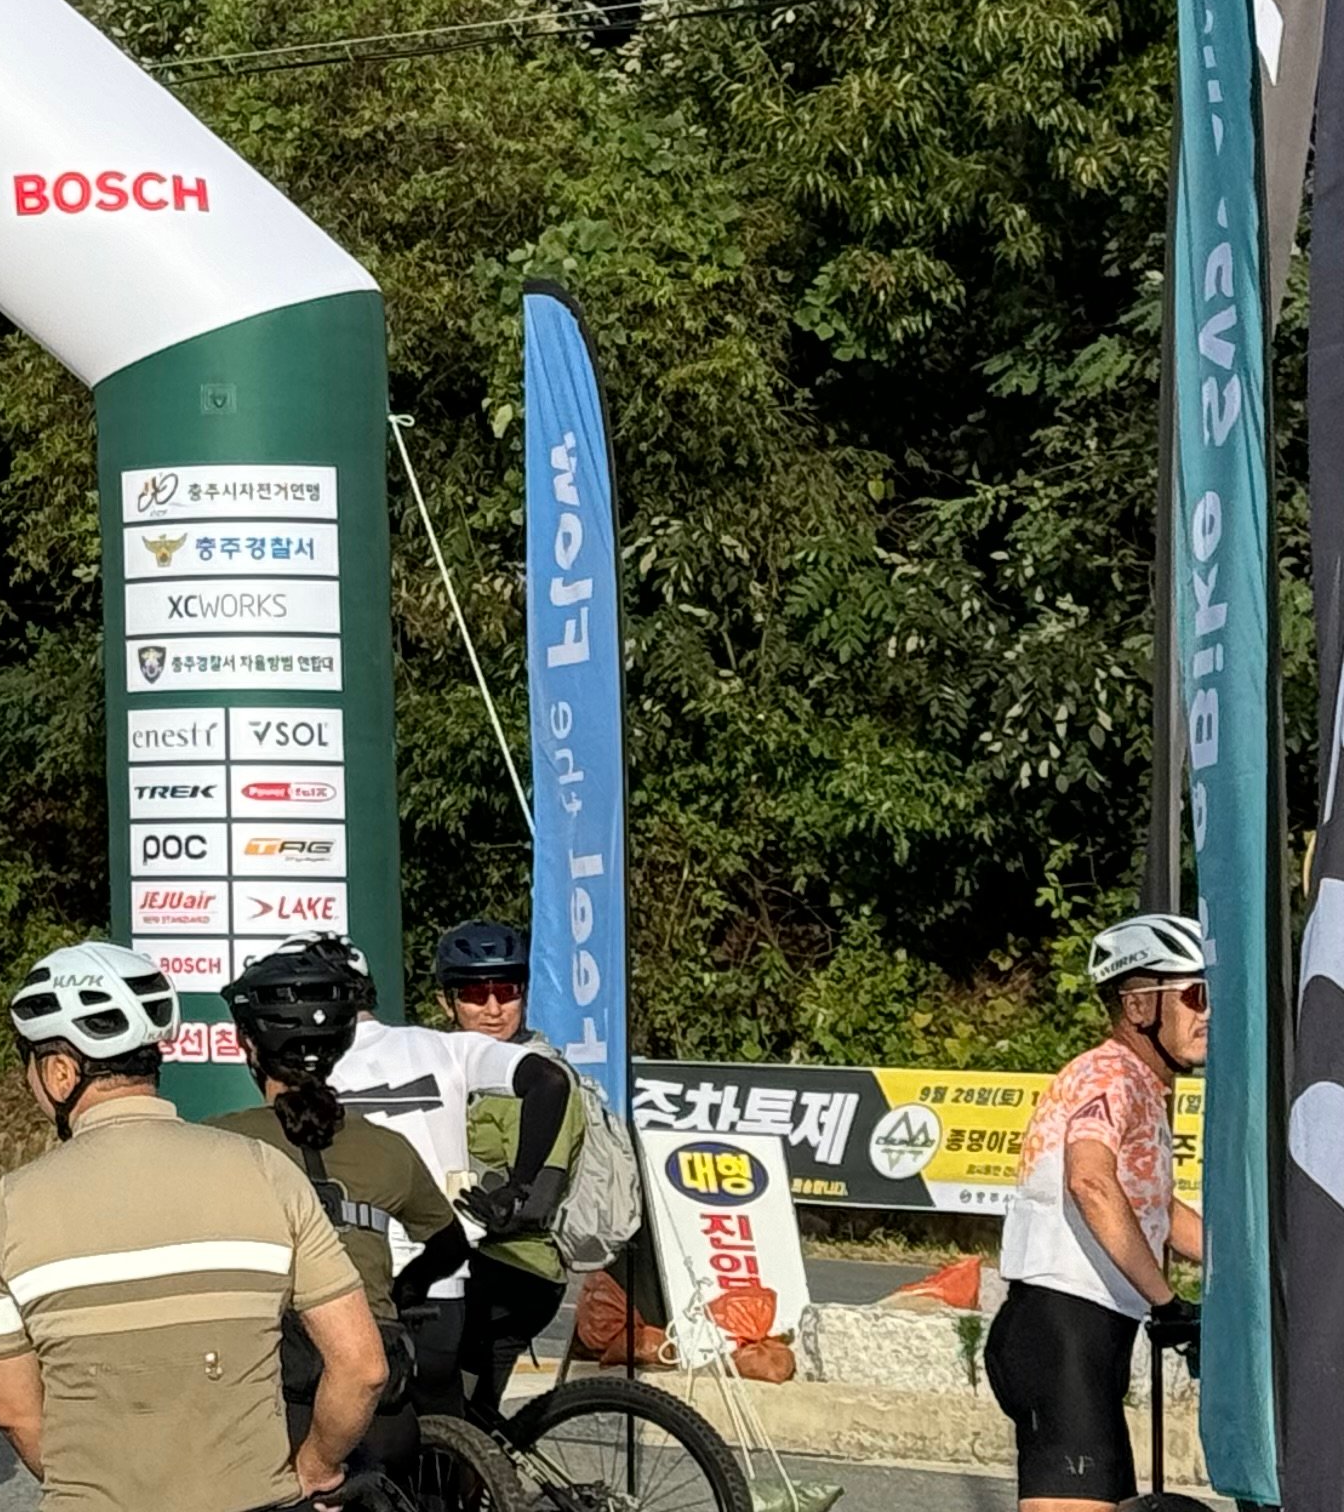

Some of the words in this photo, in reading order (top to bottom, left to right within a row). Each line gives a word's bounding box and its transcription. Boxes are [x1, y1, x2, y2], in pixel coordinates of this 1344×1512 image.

[13, 171, 210, 217] BOSCH
[195, 536, 315, 562] 충주경찰서
[167, 593, 288, 619] XCWORKS
[133, 784, 218, 801] TREK
[277, 896, 337, 921] LAKE
[677, 1151, 755, 1196] 대형
